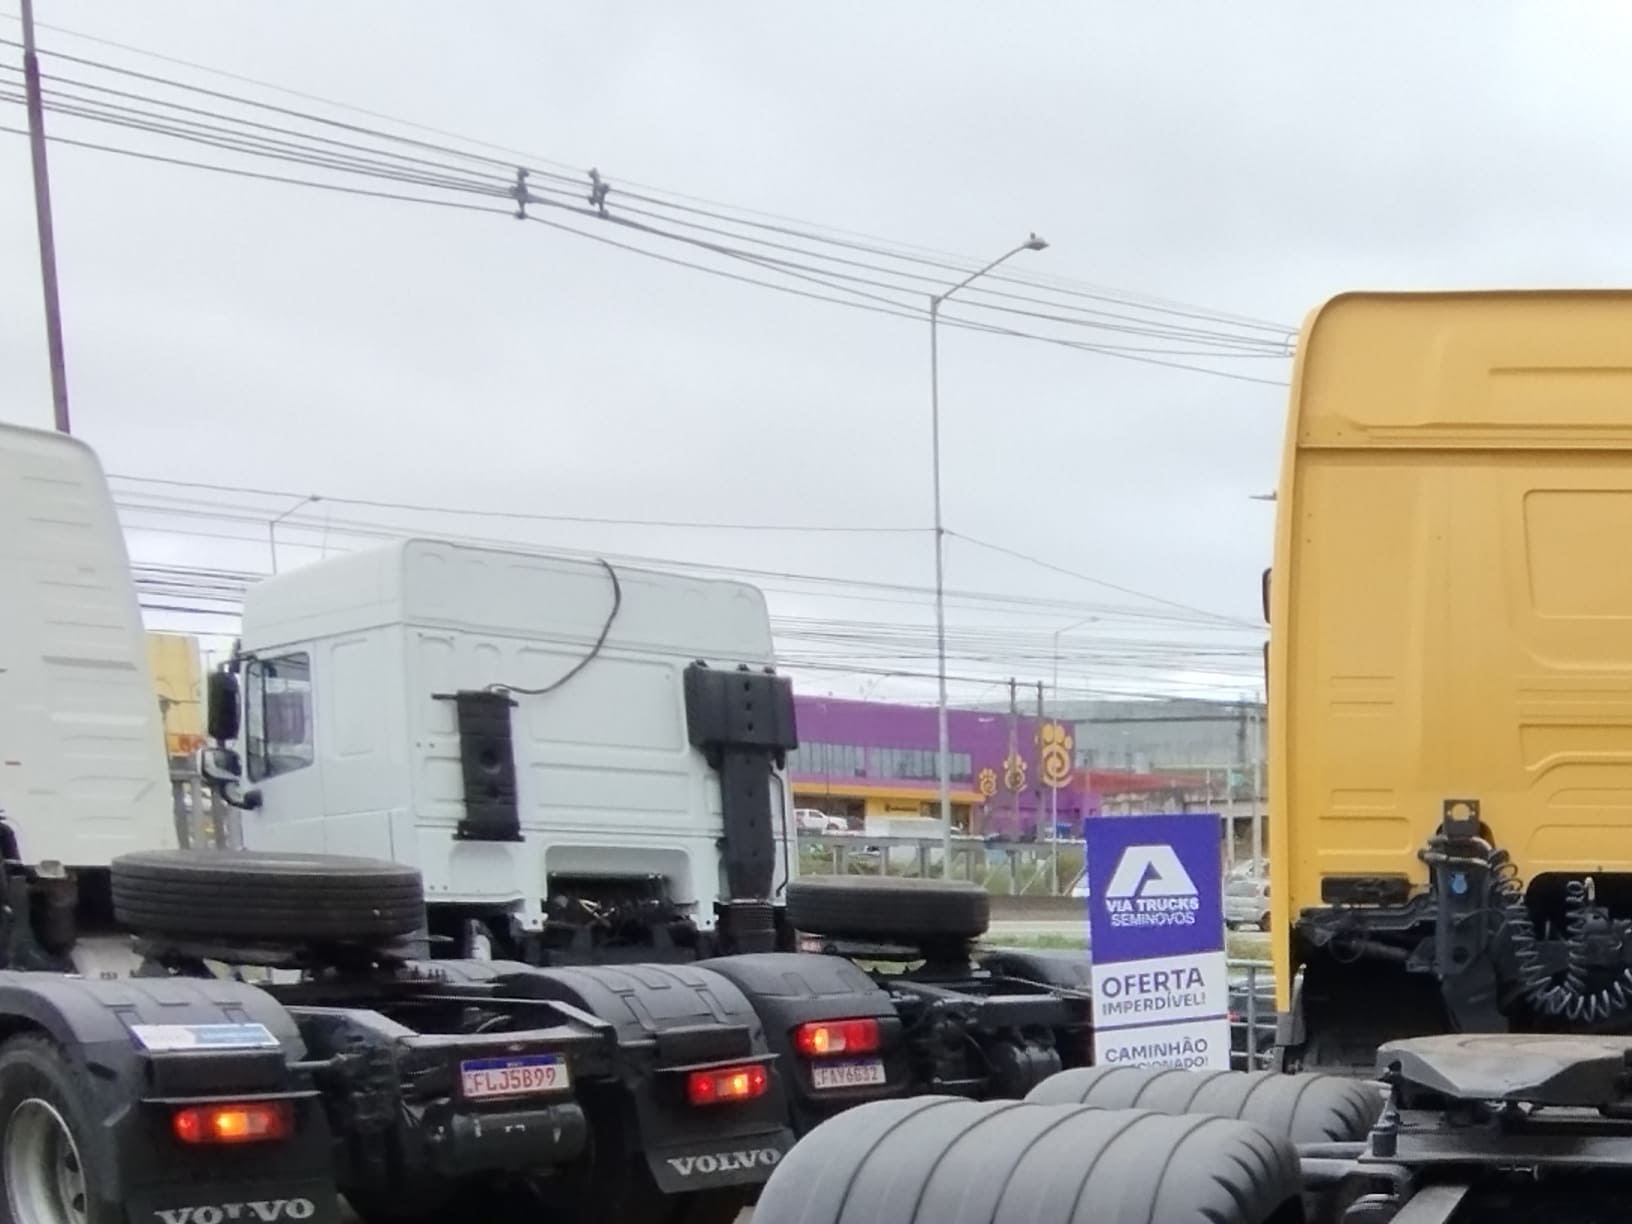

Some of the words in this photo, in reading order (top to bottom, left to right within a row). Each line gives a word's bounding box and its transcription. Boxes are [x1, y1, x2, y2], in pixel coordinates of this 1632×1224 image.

[1105, 899, 1133, 912] VIA
[1136, 897, 1200, 911] TRUCKS
[1111, 911, 1196, 926] SEMINOVOS
[1102, 967, 1205, 998] OFERTA
[1102, 992, 1206, 1015] IMPERDÍVEL!
[1105, 1036, 1208, 1062] CAMINHÃO
[472, 1067, 556, 1093] FLJ5B99
[666, 1148, 781, 1176] VOLVO
